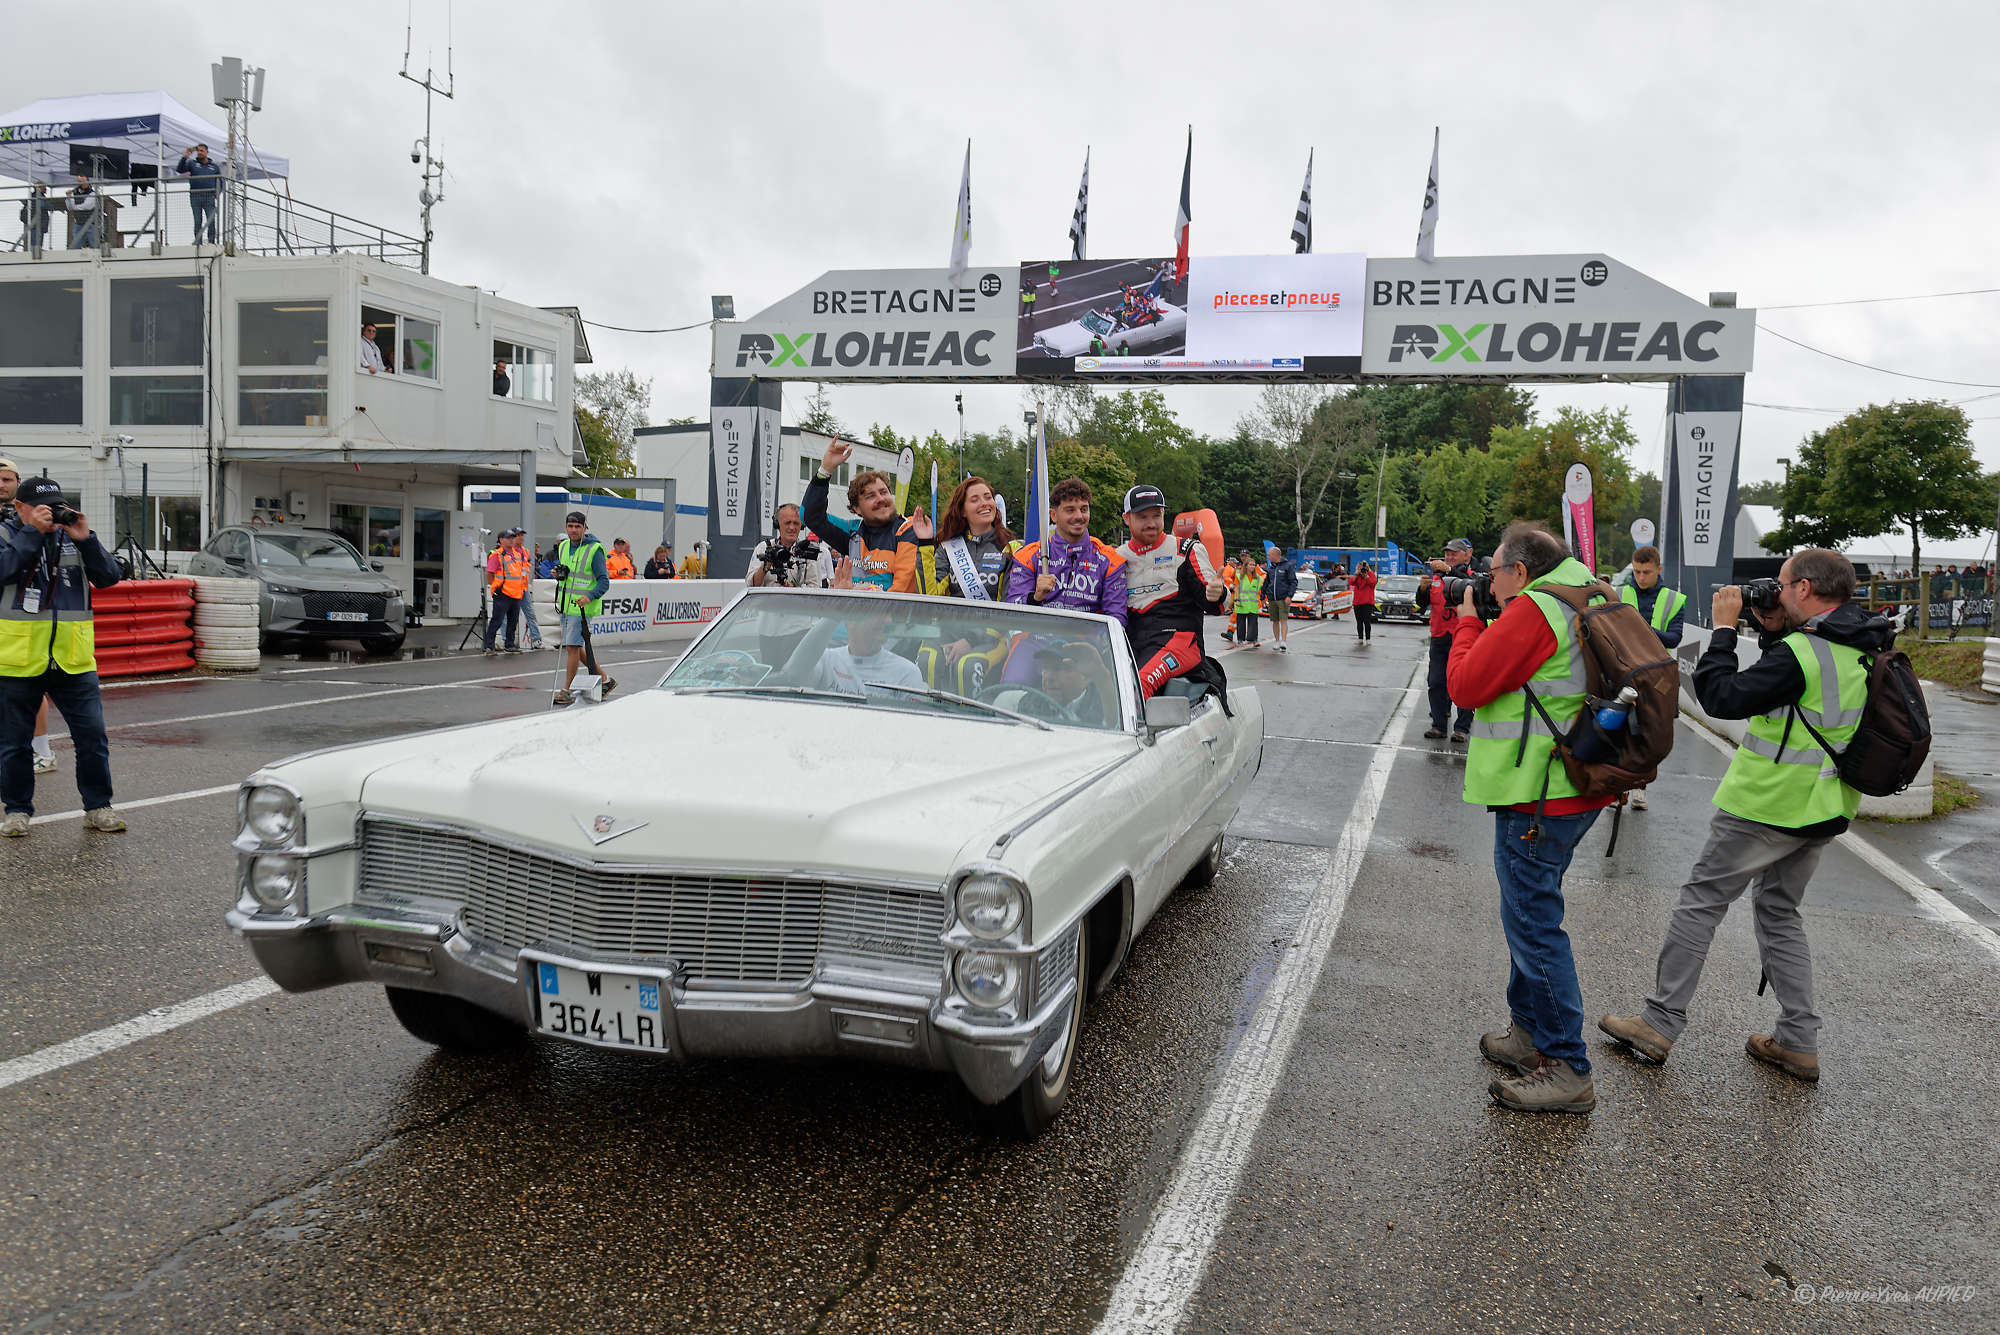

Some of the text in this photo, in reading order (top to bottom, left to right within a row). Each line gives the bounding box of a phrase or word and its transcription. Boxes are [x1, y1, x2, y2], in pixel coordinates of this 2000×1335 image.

[0, 123, 71, 141] XLOHEAC
[813, 288, 976, 314] BRETAGNE
[1214, 290, 1341, 309] piecesetpneus
[1373, 277, 1576, 306] BRETAGNE
[727, 431, 739, 518] BRETAGNE
[1694, 441, 1714, 544] BRETAGNE
[954, 548, 980, 592] BRETAGNE
[1047, 571, 1099, 594] NJOY
[601, 597, 643, 616] FFSA
[657, 600, 701, 621] RALLYCROSS
[593, 620, 646, 635] RALLYCROSS
[550, 1002, 655, 1048] 364-LR
